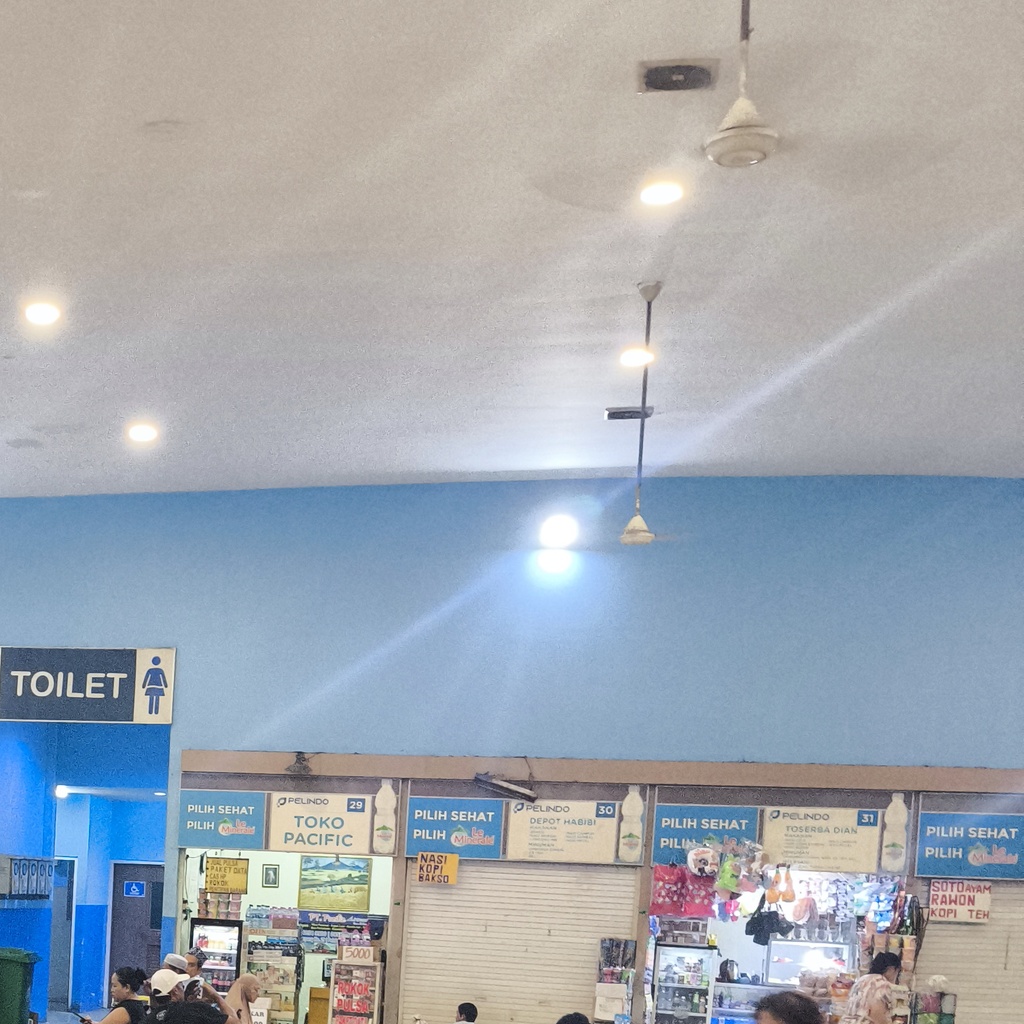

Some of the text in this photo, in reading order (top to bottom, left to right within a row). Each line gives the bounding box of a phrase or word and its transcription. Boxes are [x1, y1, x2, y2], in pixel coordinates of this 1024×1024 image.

[10, 670, 128, 699] TOILET
[287, 796, 330, 806] PELINDO
[348, 801, 363, 810] 29
[187, 804, 254, 815] PILIH SEHAT
[525, 804, 571, 814] PELINDO
[597, 805, 614, 815] 30
[414, 809, 495, 822] PILIH SEHAT
[781, 812, 830, 822] PELINDO
[860, 813, 874, 824] 31
[186, 820, 215, 830] PILIH
[293, 815, 345, 830] TOKO
[529, 817, 597, 827] DEPOT HABIBI
[661, 817, 749, 831] PILIH SEHAT
[412, 829, 446, 841] PILIH
[785, 825, 858, 834] TOSERBA DIAN
[926, 825, 1018, 839] PILIH SEHAT
[283, 832, 354, 847] PACIFIC
[924, 846, 963, 859] PILIH
[420, 853, 447, 864] NASI
[210, 866, 232, 874] PAKET
[418, 863, 443, 874] KOPI
[418, 873, 449, 884] BAKSO
[931, 881, 992, 894] SOTO AYAM
[931, 894, 976, 906] RAWON
[930, 907, 990, 920] KOPI TEH
[345, 947, 371, 959] 5000
[337, 981, 370, 996] ROKOK
[336, 998, 369, 1013] PULSA
